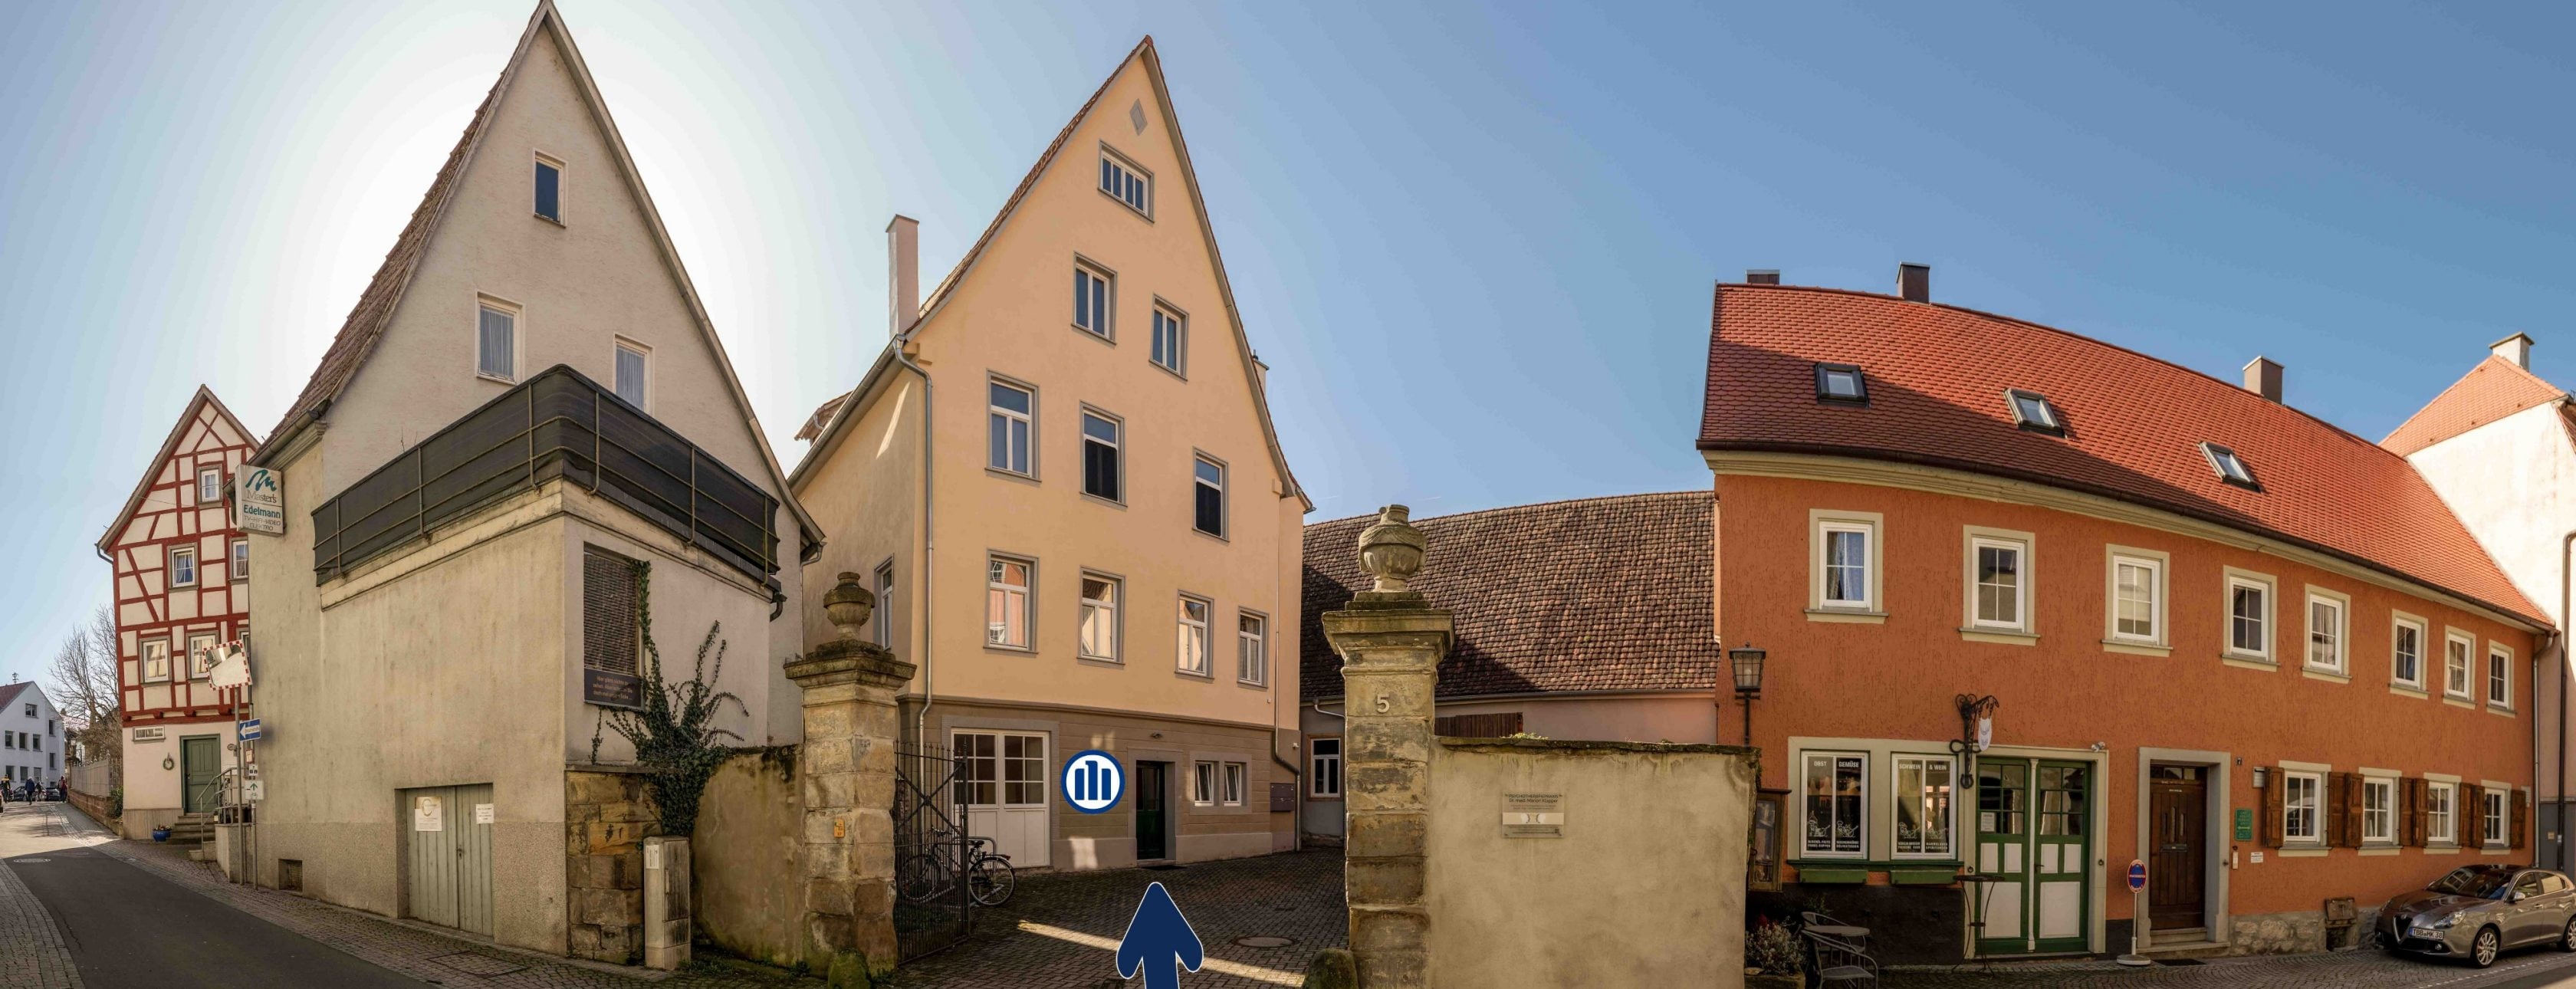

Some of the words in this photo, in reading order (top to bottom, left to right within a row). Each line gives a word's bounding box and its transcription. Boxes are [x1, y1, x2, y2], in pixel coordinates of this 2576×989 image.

[244, 504, 281, 518] Edelmann
[1377, 693, 1390, 713] 5
[2435, 932, 2443, 940] 38
